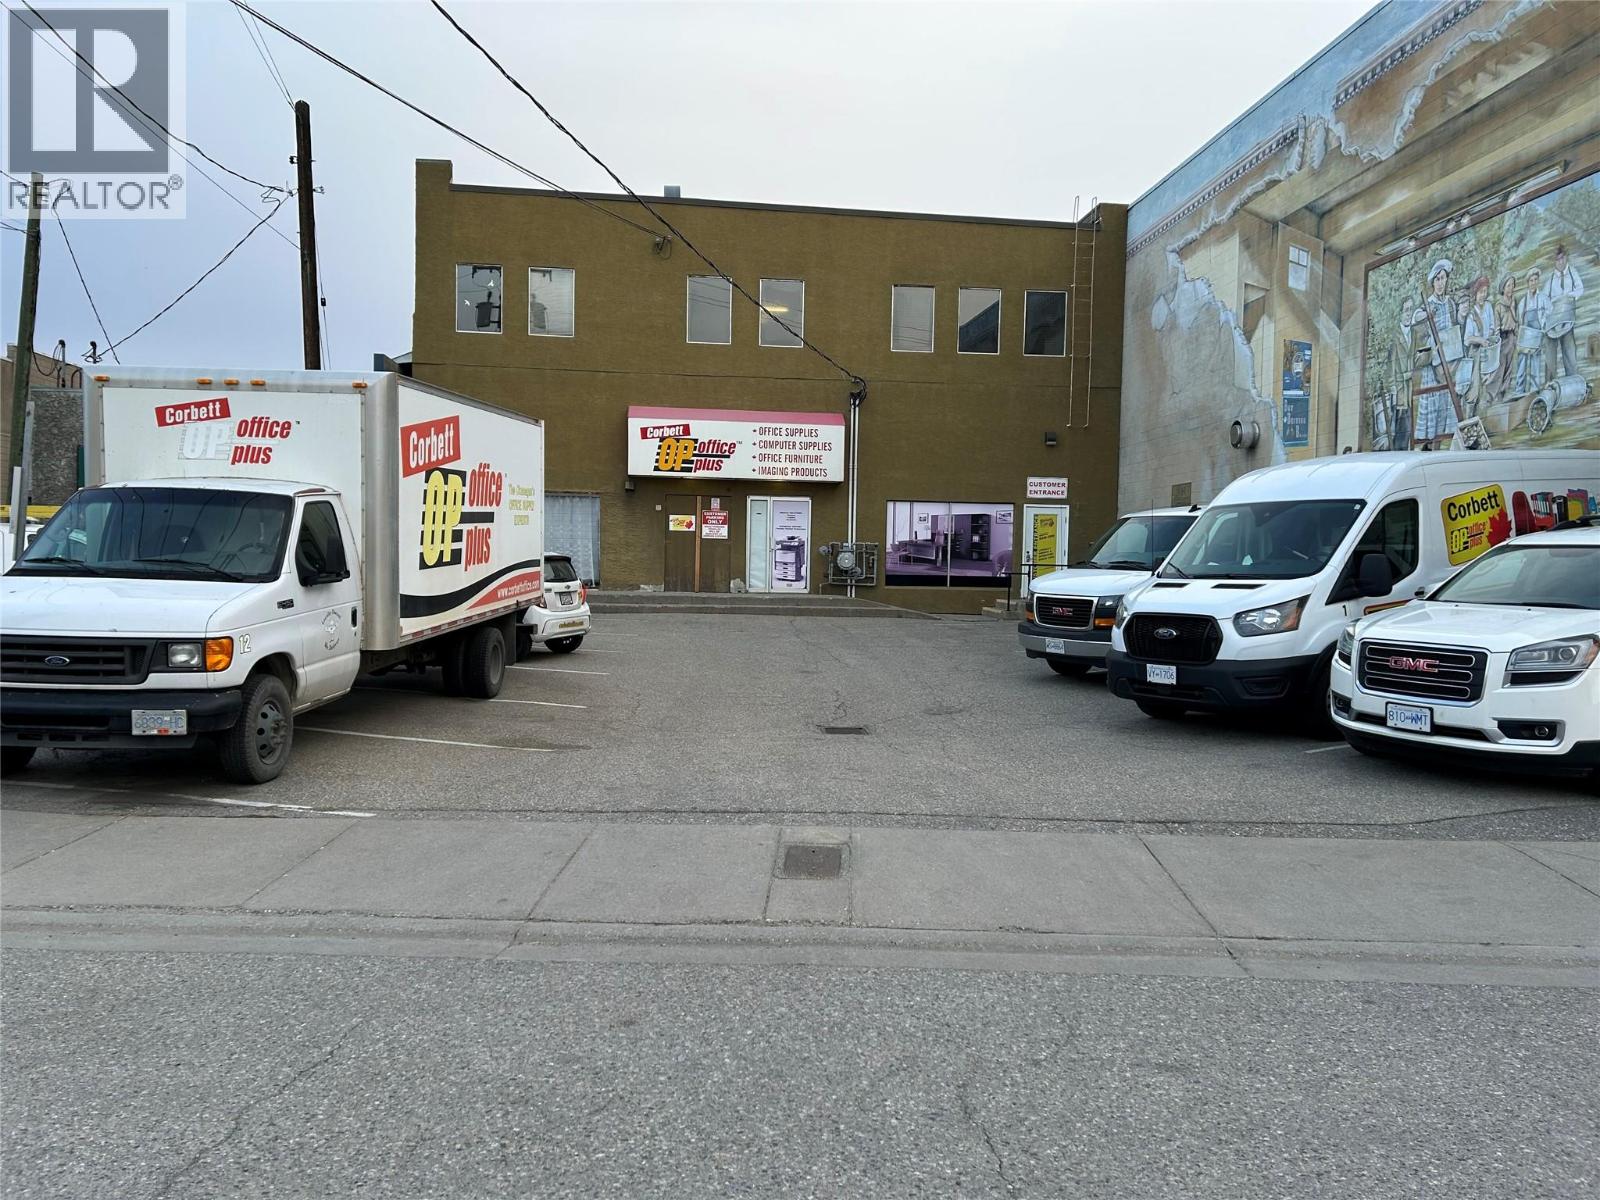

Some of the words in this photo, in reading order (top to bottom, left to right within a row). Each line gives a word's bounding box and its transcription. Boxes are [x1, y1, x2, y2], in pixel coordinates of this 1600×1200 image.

[165, 401, 221, 423] Corbett
[236, 416, 292, 439] office
[647, 425, 683, 438] Corbett
[758, 426, 783, 437] OFFICE
[784, 427, 819, 438] SUPPLIES
[230, 444, 273, 465] plus
[409, 423, 454, 468] Corbett
[657, 437, 695, 471] OP
[697, 439, 737, 455] office
[758, 439, 797, 450] COMPUTER
[798, 441, 833, 451] SUPPLIES
[693, 458, 724, 473] plus
[758, 453, 782, 463] OFFICE
[784, 453, 823, 464] FURNITURE
[758, 466, 789, 476] IMAGING
[791, 467, 828, 477] PRODUCTS
[422, 470, 463, 566] OP
[468, 462, 502, 507] office
[1447, 490, 1500, 521] Corbett
[464, 526, 491, 572] plus
[1452, 528, 1468, 553] OP
[1052, 606, 1073, 616] GMC
[238, 633, 251, 654] 12
[1389, 655, 1440, 673] GMC
